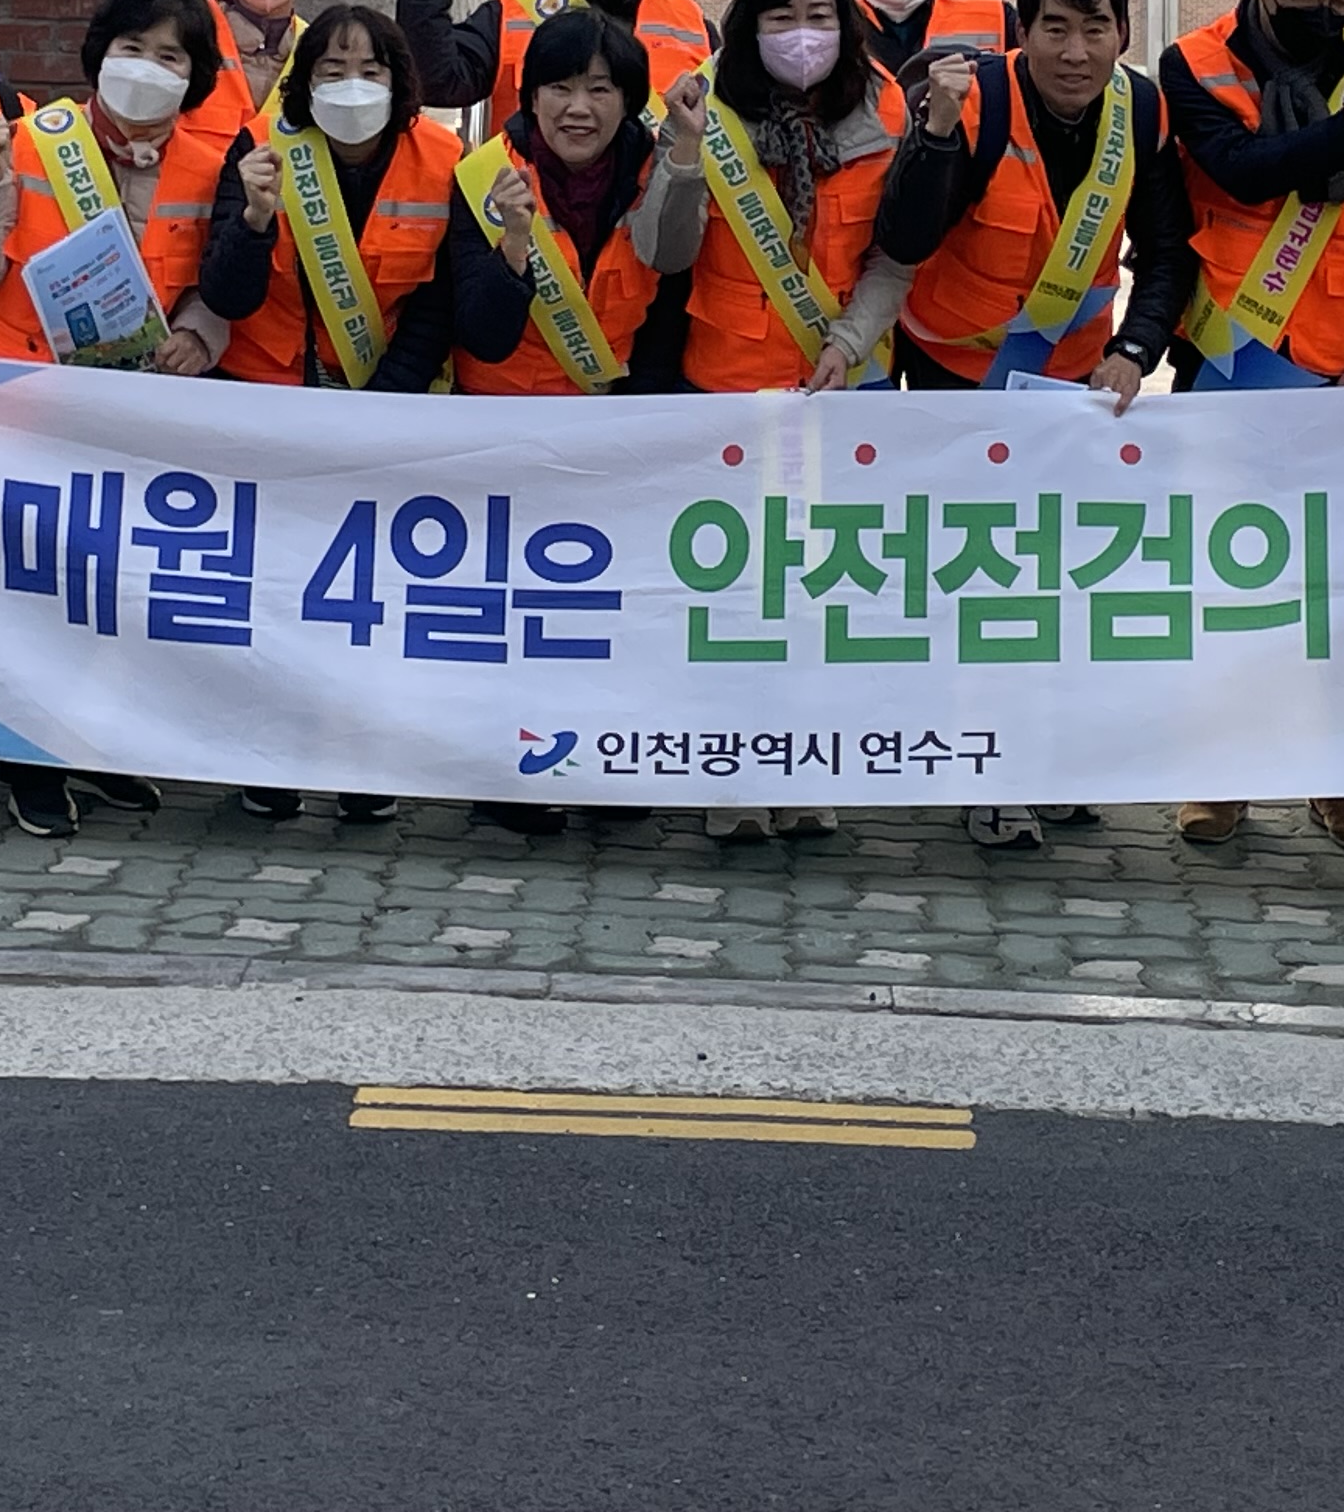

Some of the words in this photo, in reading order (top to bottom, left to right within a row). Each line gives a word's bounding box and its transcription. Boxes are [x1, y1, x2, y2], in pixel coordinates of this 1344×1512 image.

[57, 142, 103, 221] 안전한
[288, 143, 330, 226] 안전한
[1066, 191, 1110, 273] 만들기
[1, 470, 257, 648] 매월
[302, 493, 622, 664] 4일은
[668, 492, 1331, 663] 안전점검의
[596, 731, 841, 778] 인천광역시
[858, 731, 1002, 776] 연수구
